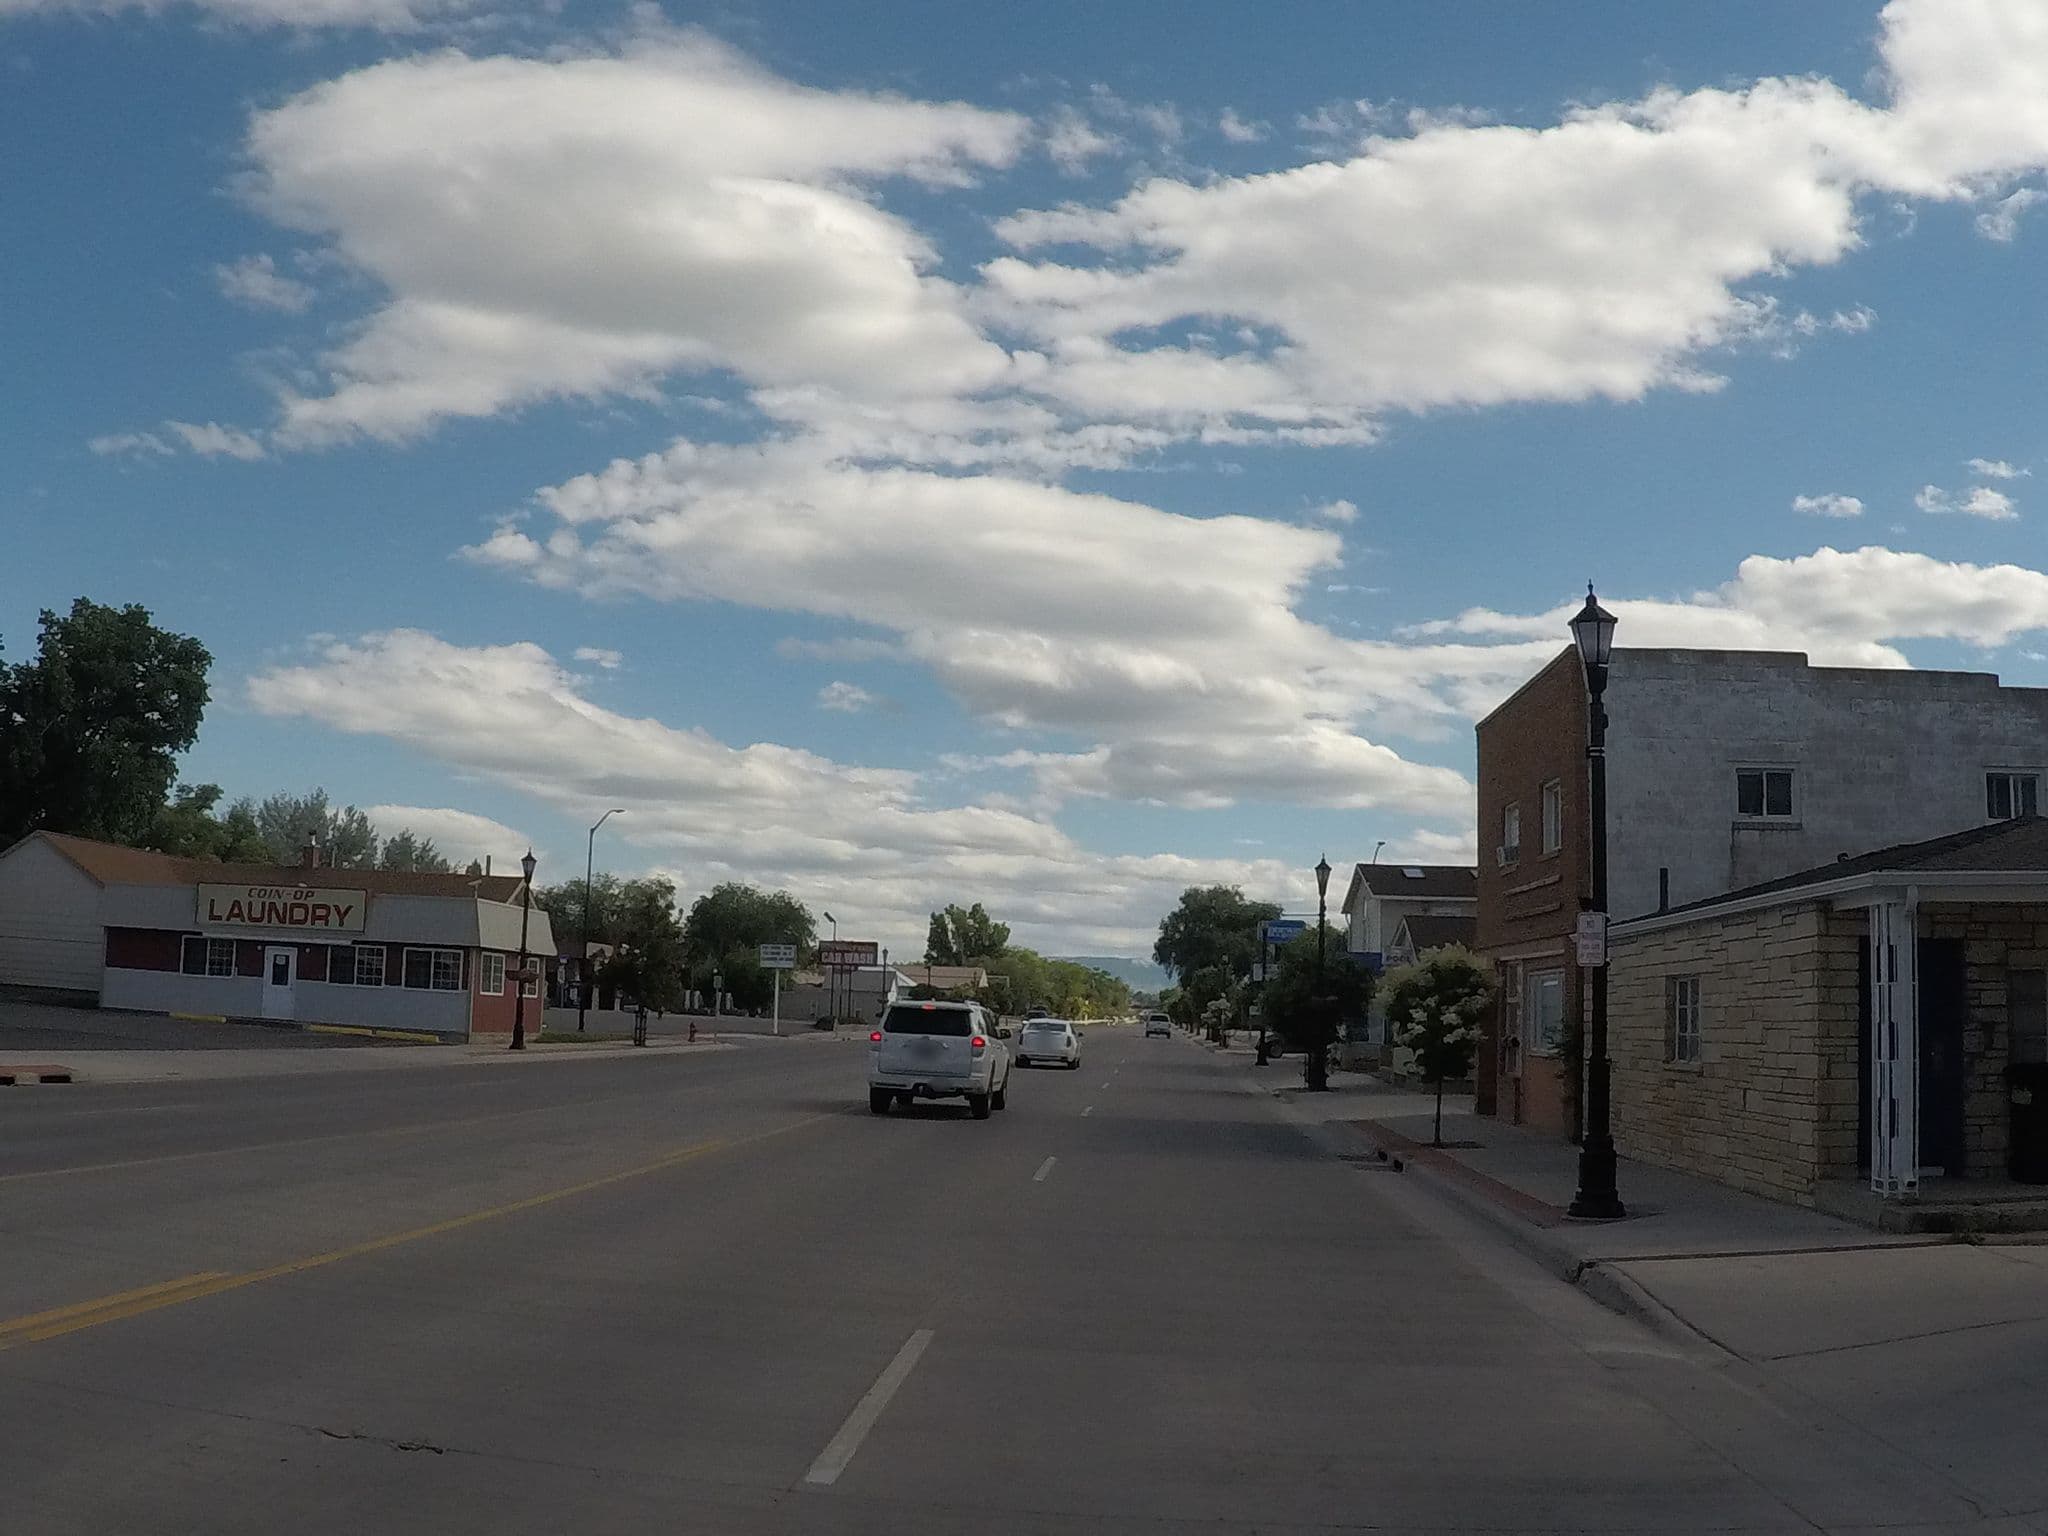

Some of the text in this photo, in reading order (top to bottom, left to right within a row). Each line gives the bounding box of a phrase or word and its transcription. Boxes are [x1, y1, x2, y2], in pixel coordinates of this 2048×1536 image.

[248, 887, 315, 900] COIN-OP
[208, 898, 354, 927] LAUNDRY
[821, 952, 873, 964] CAR WASH
